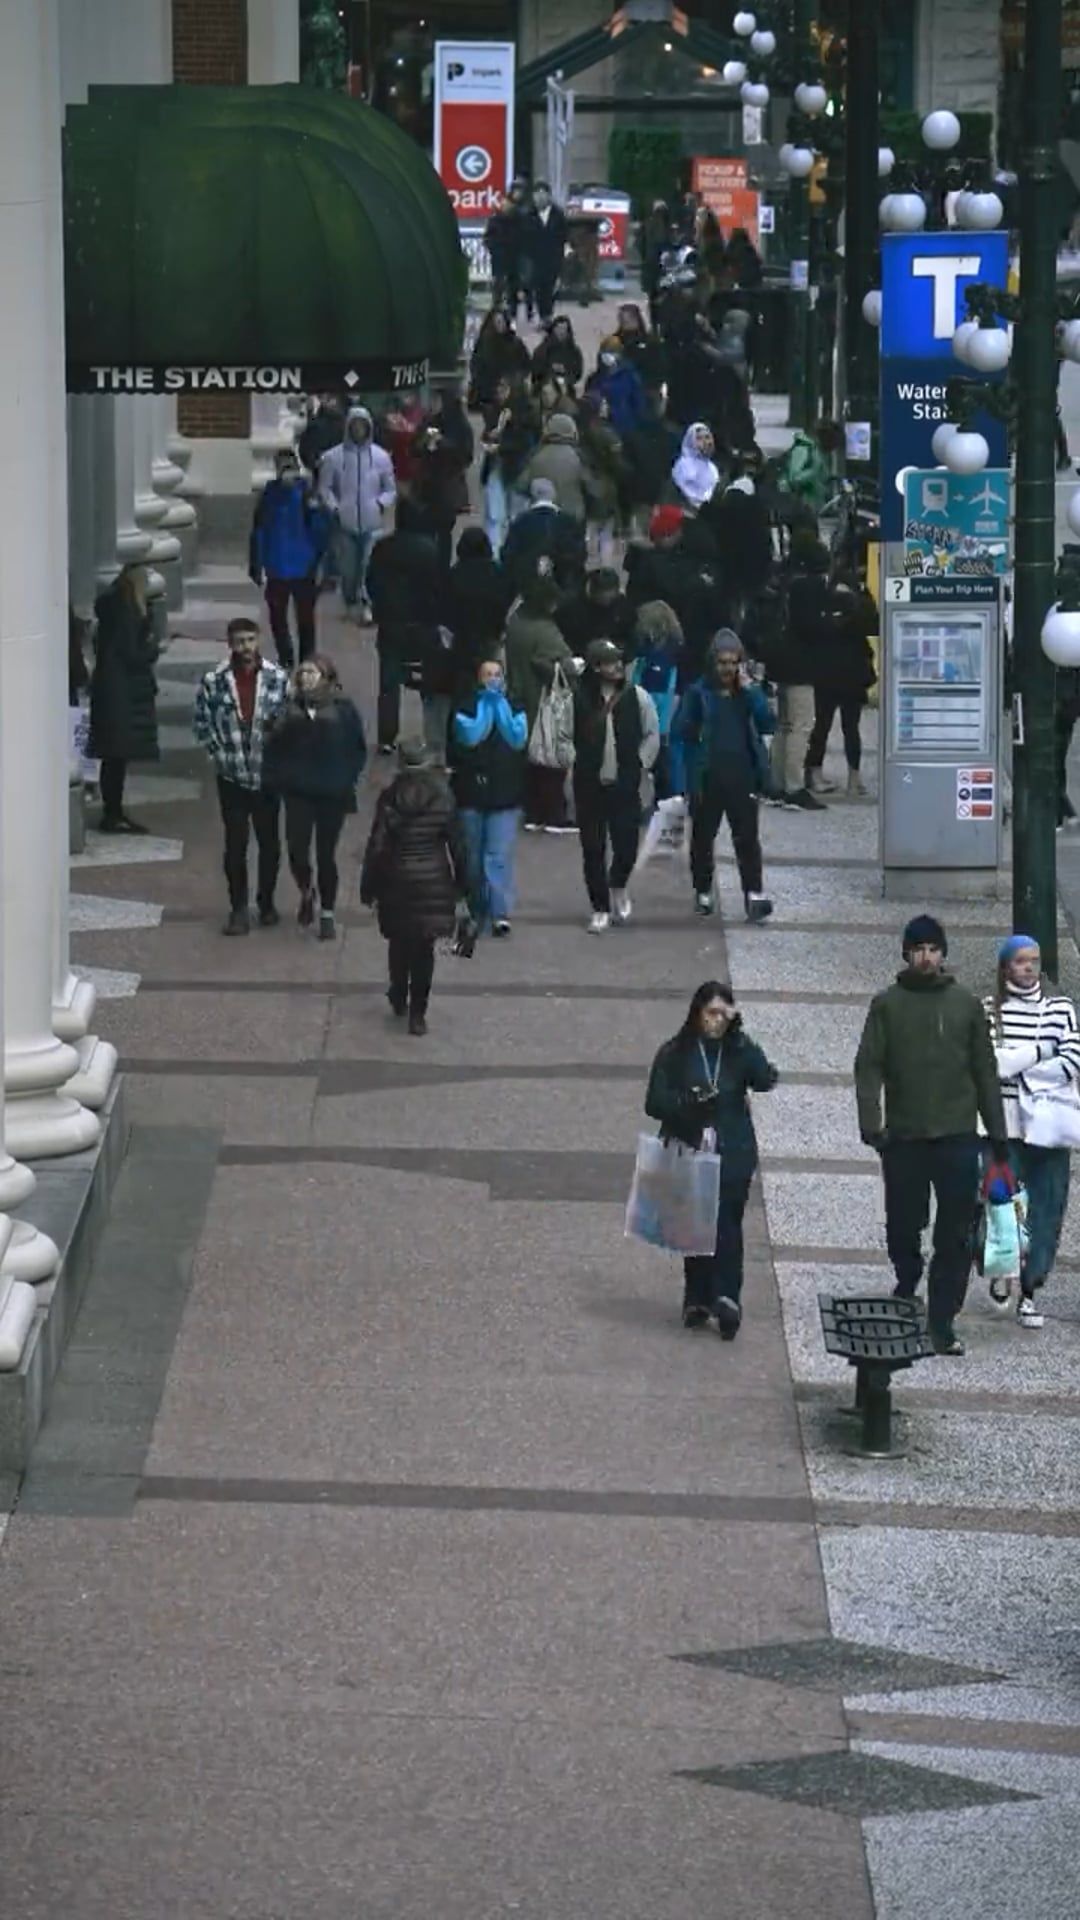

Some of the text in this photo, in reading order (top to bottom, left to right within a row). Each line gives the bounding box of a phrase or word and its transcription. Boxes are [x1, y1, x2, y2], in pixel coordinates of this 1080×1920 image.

[912, 256, 981, 339] T
[90, 366, 302, 389] THE STATION
[897, 383, 948, 400] Water
[915, 585, 994, 595] Plan Your Trip Here
